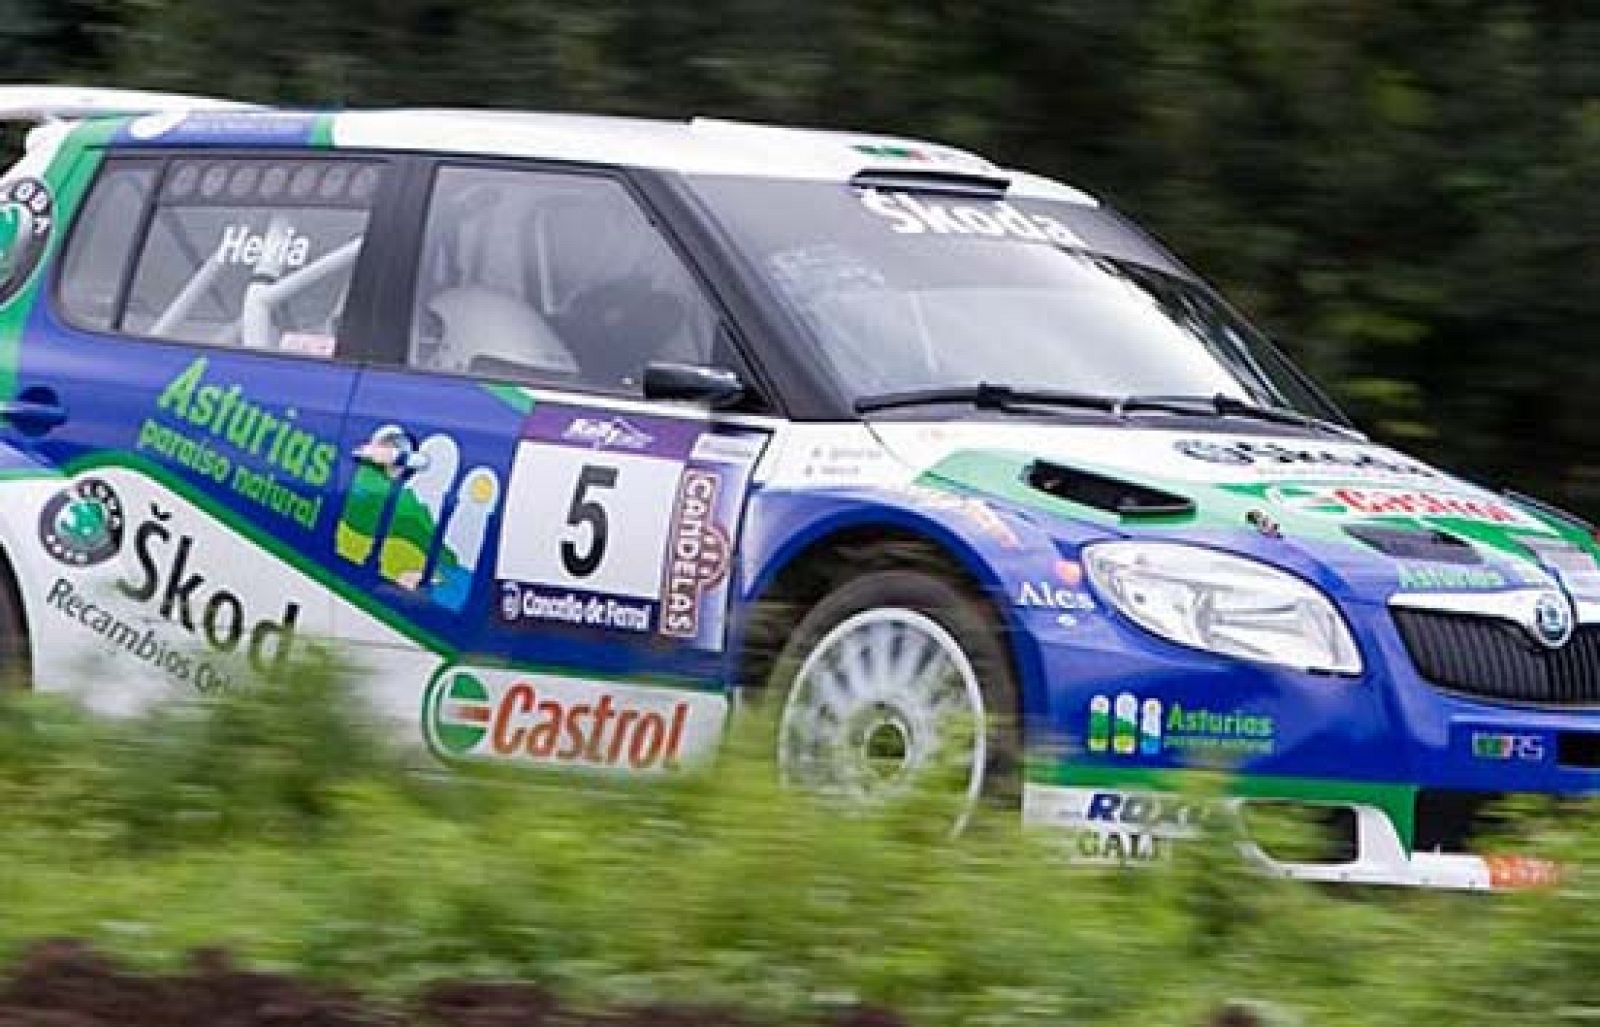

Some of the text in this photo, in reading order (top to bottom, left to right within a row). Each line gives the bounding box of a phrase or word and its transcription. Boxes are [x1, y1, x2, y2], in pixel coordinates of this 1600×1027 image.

[157, 356, 337, 486] Asturias
[232, 464, 323, 530] natural
[559, 465, 619, 578] 5
[47, 577, 191, 680] Recambios
[492, 682, 690, 768] Castrol
[1166, 701, 1276, 737] Asturias
